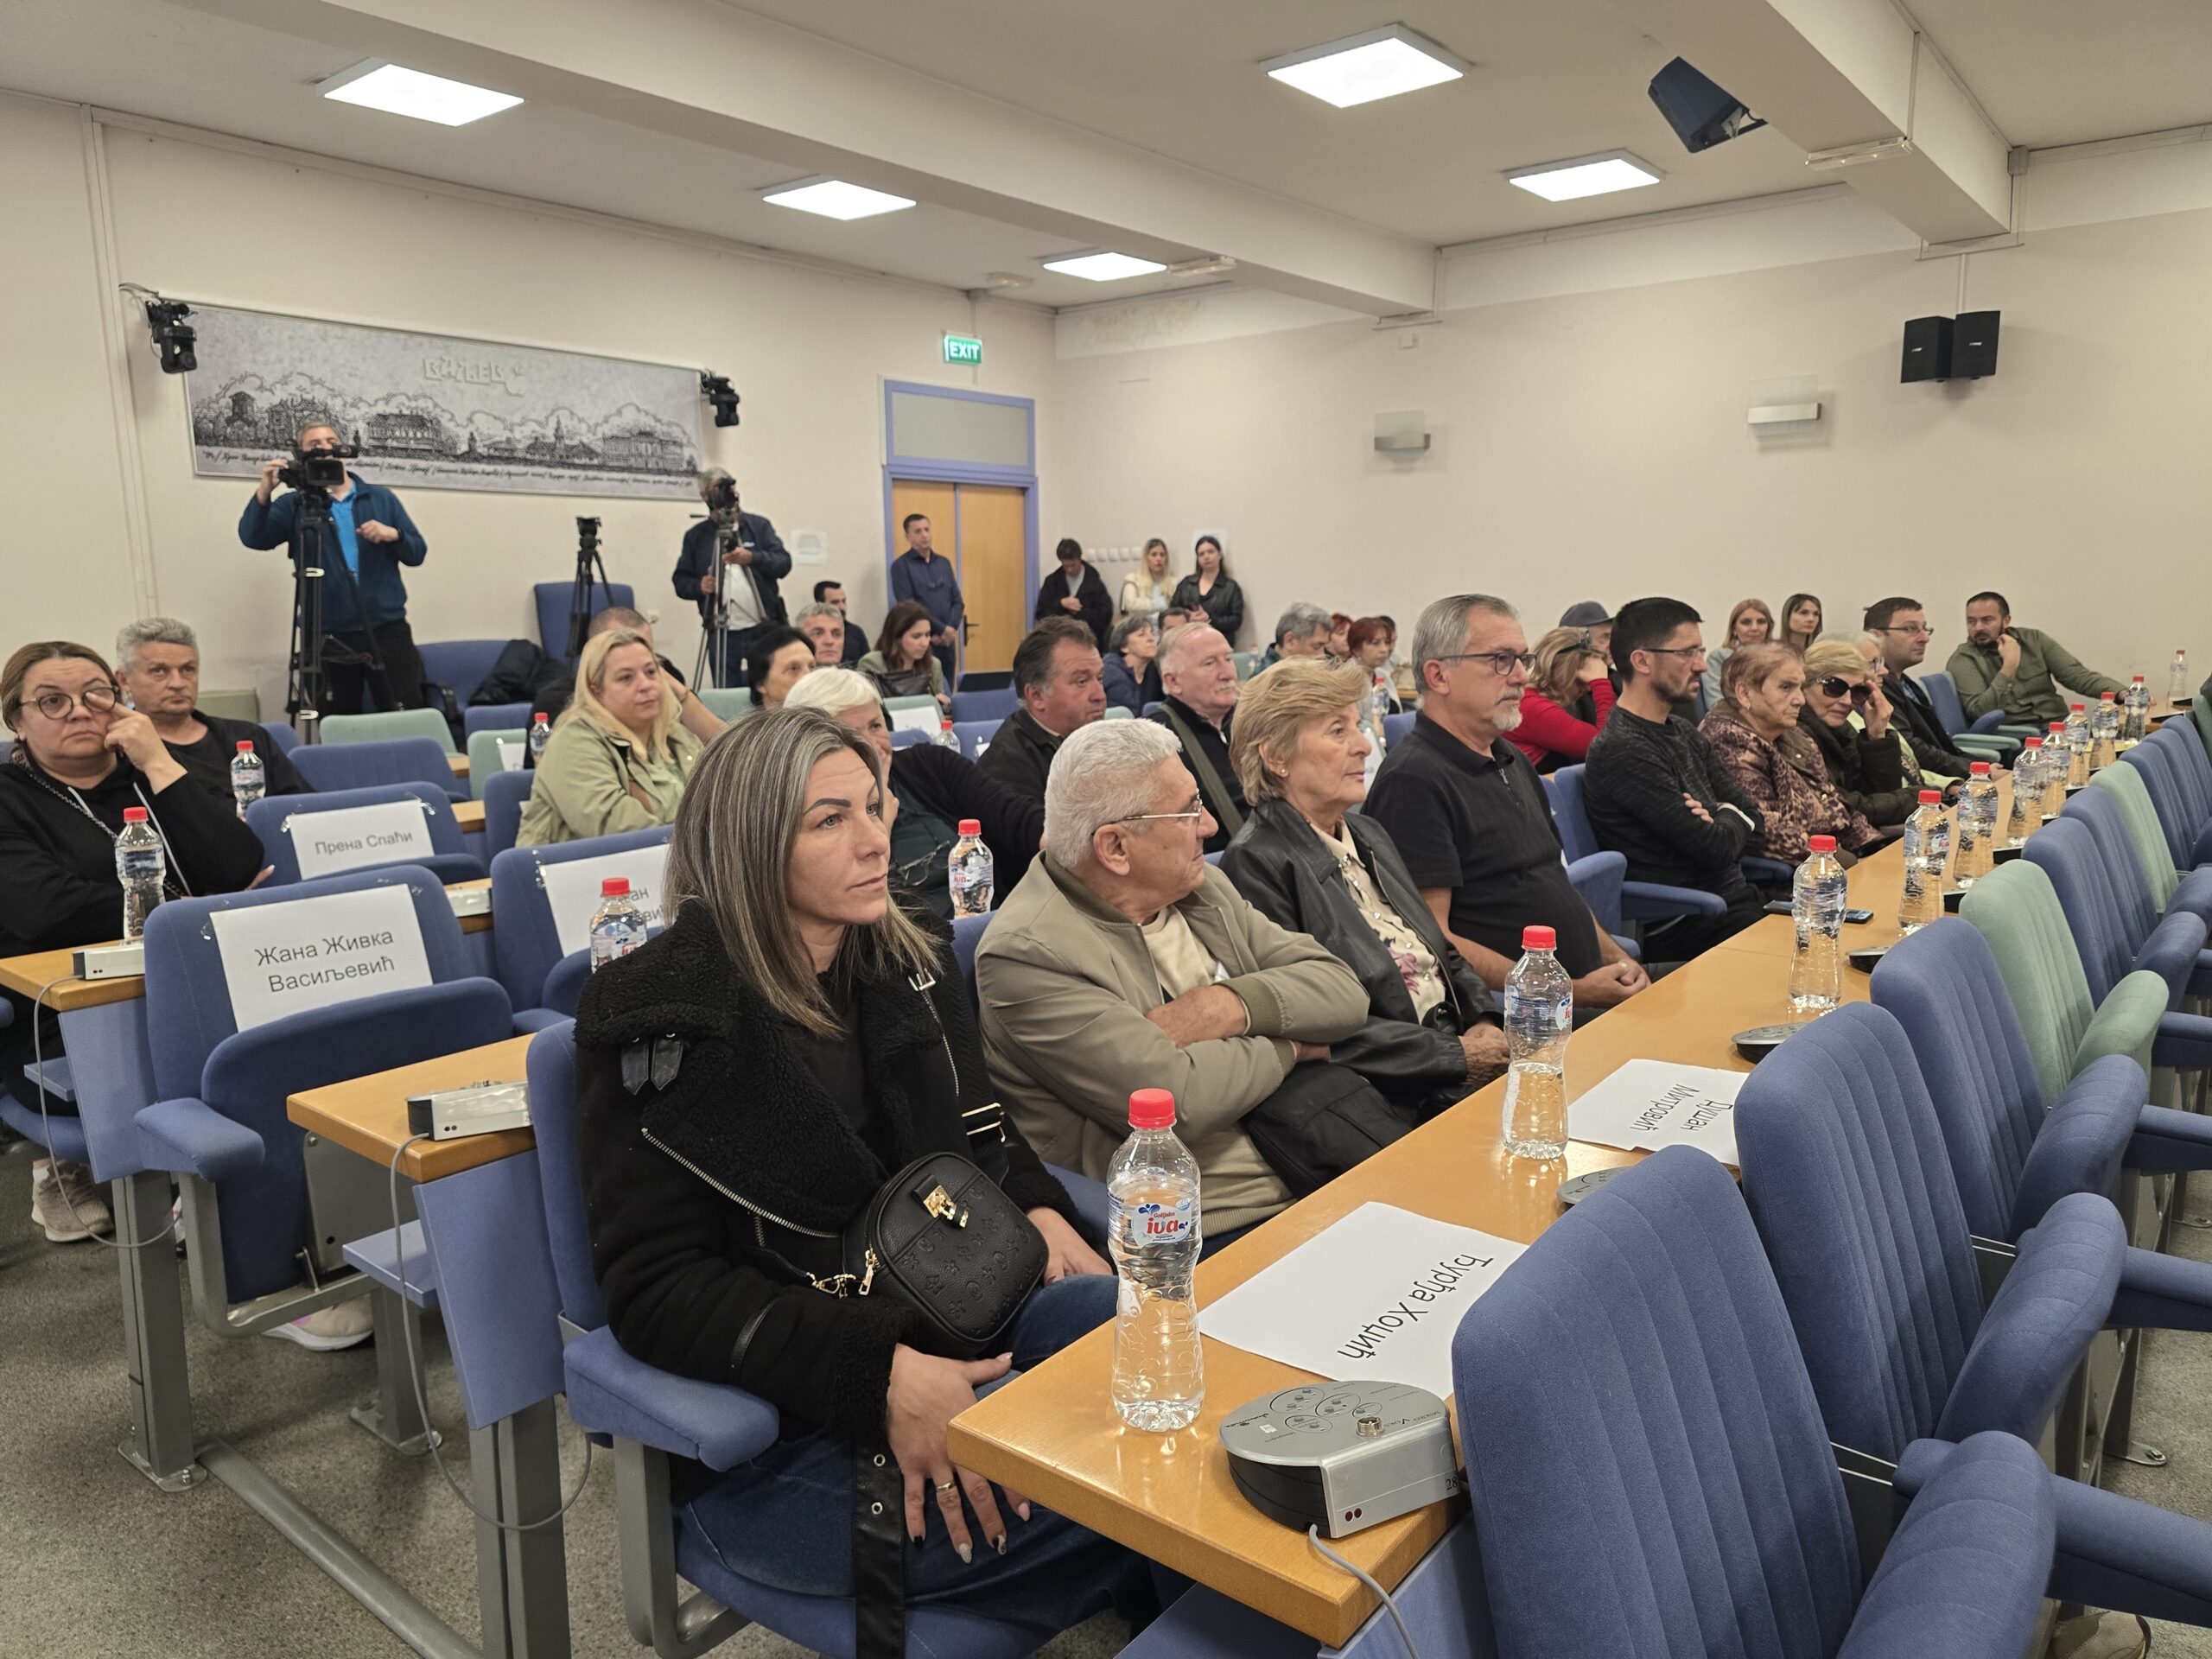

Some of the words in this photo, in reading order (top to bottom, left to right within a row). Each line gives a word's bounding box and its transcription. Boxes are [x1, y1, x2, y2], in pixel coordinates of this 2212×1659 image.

[949, 340, 980, 359] EXIT
[315, 841, 364, 855] Прена
[365, 830, 413, 848] Спаћи
[254, 946, 318, 966] Жана
[322, 931, 394, 955] Живка
[268, 956, 395, 992] Васиљевић
[1630, 1084, 1700, 1131] Митровић
[1680, 1098, 1734, 1131] Душан
[1147, 1217, 1179, 1234] iva
[1408, 1254, 1494, 1303] Ђурђа
[1337, 1301, 1429, 1359] Хоџић
[1445, 1476, 1458, 1491] 28
